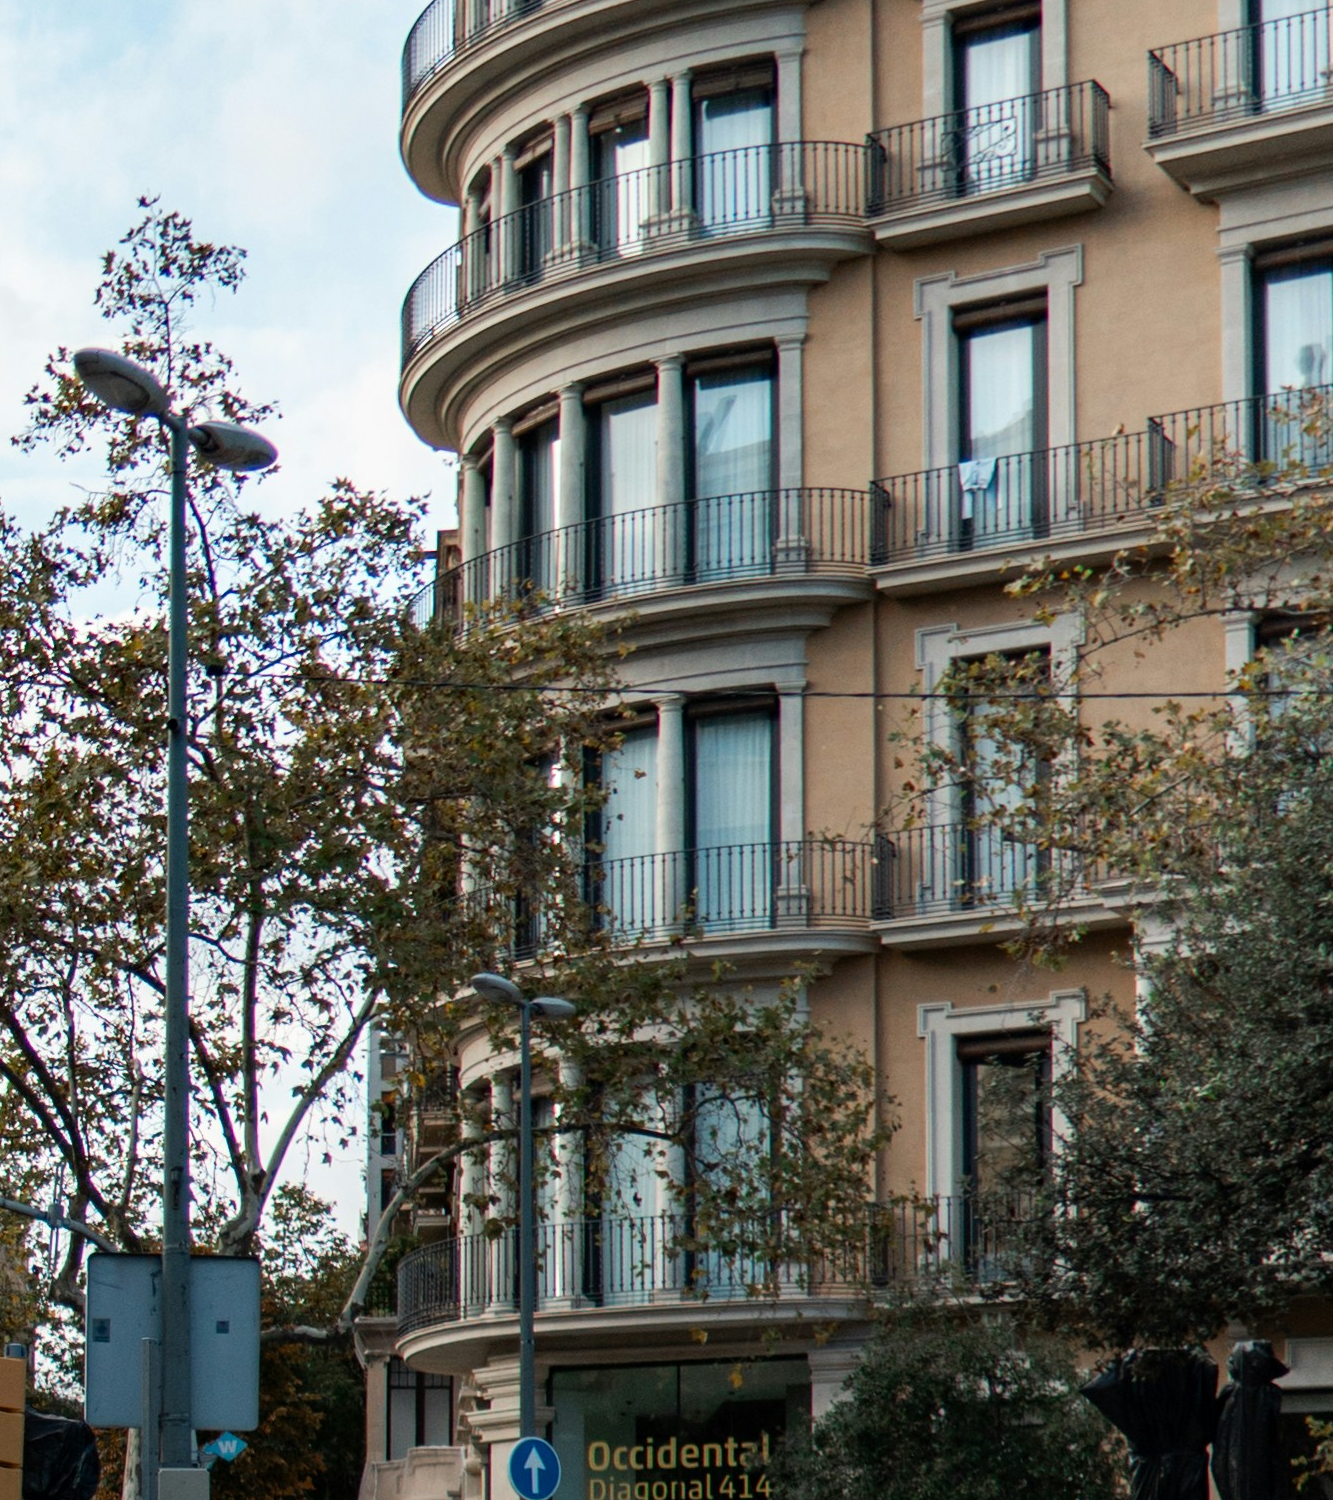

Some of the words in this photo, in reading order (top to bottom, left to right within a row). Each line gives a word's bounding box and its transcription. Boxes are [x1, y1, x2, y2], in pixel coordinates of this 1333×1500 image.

[218, 1440, 238, 1454] W
[588, 1432, 771, 1472] Occidental
[719, 1474, 773, 1500] 414
